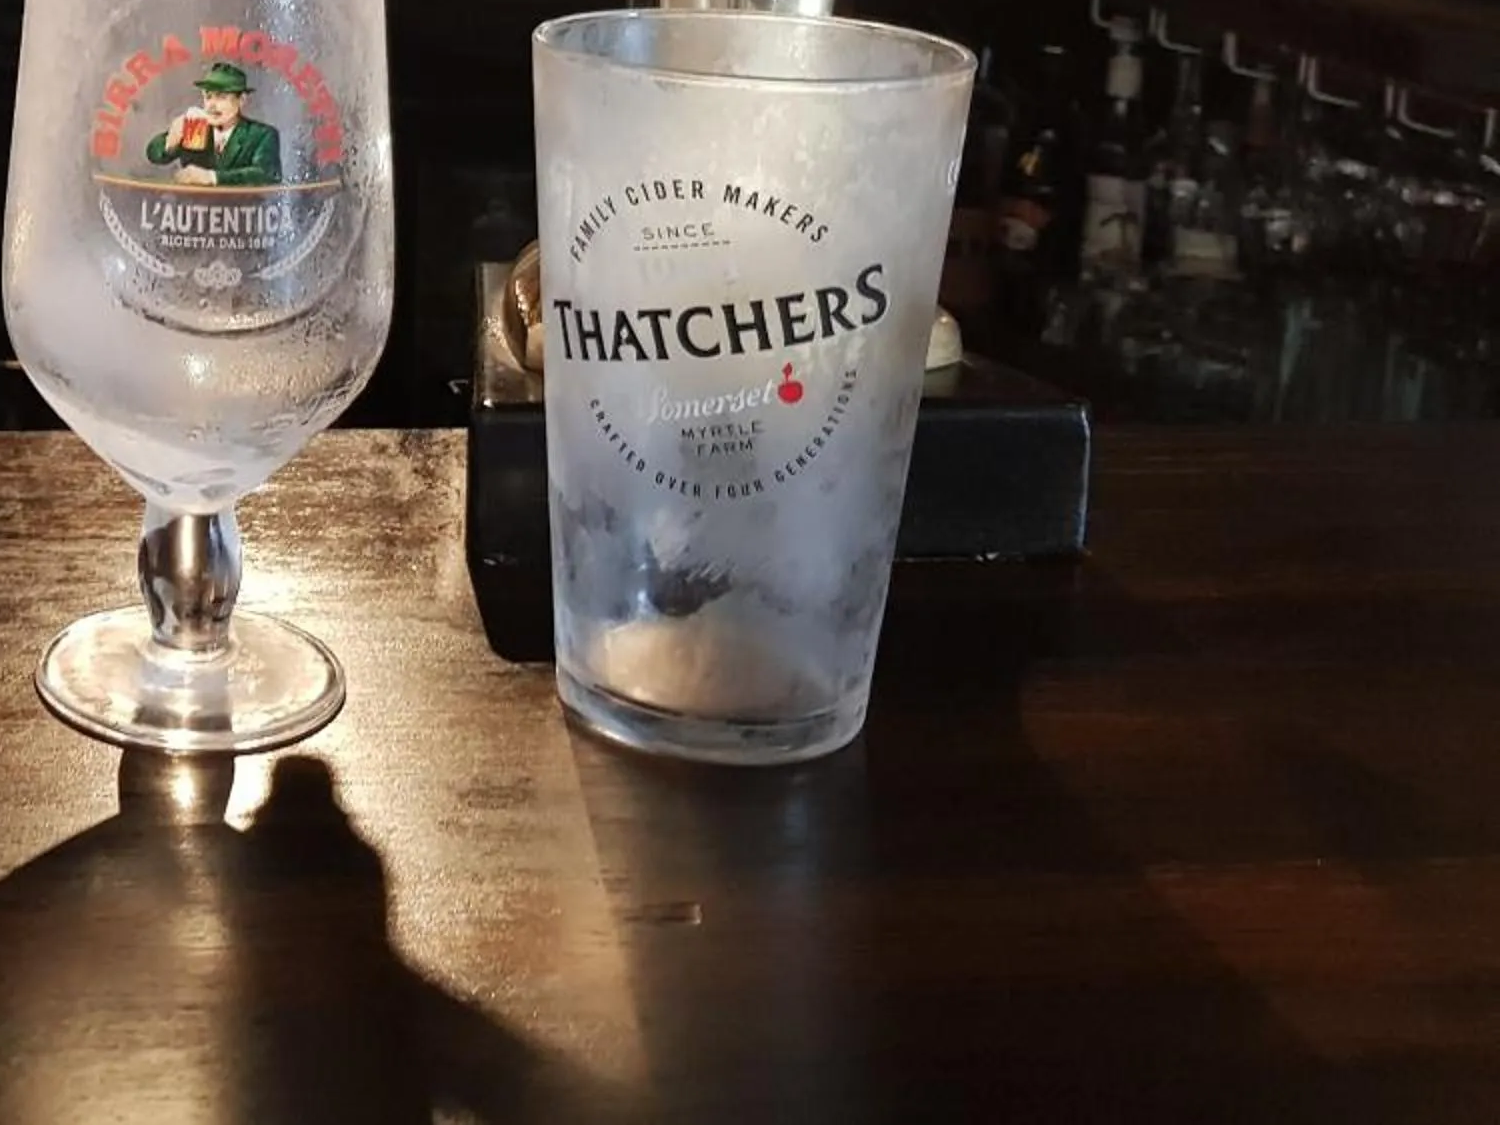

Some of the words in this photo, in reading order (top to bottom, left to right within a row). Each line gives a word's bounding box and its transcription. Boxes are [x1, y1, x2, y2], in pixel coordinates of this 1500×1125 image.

[90, 32, 192, 159] BIRRA
[571, 196, 618, 262] FAMILY
[625, 178, 705, 208] CIDER
[722, 183, 830, 244] MAKERS
[641, 222, 716, 241] SINCE
[553, 263, 890, 362] THATCHERS
[646, 378, 774, 424] Somerset
[680, 419, 764, 441] MYRTLE
[589, 398, 647, 473] CRAFTED
[655, 471, 702, 498] OVER
[714, 480, 765, 500] FOUR
[774, 368, 858, 483] GENERATIONS
[694, 439, 756, 456] FARM
